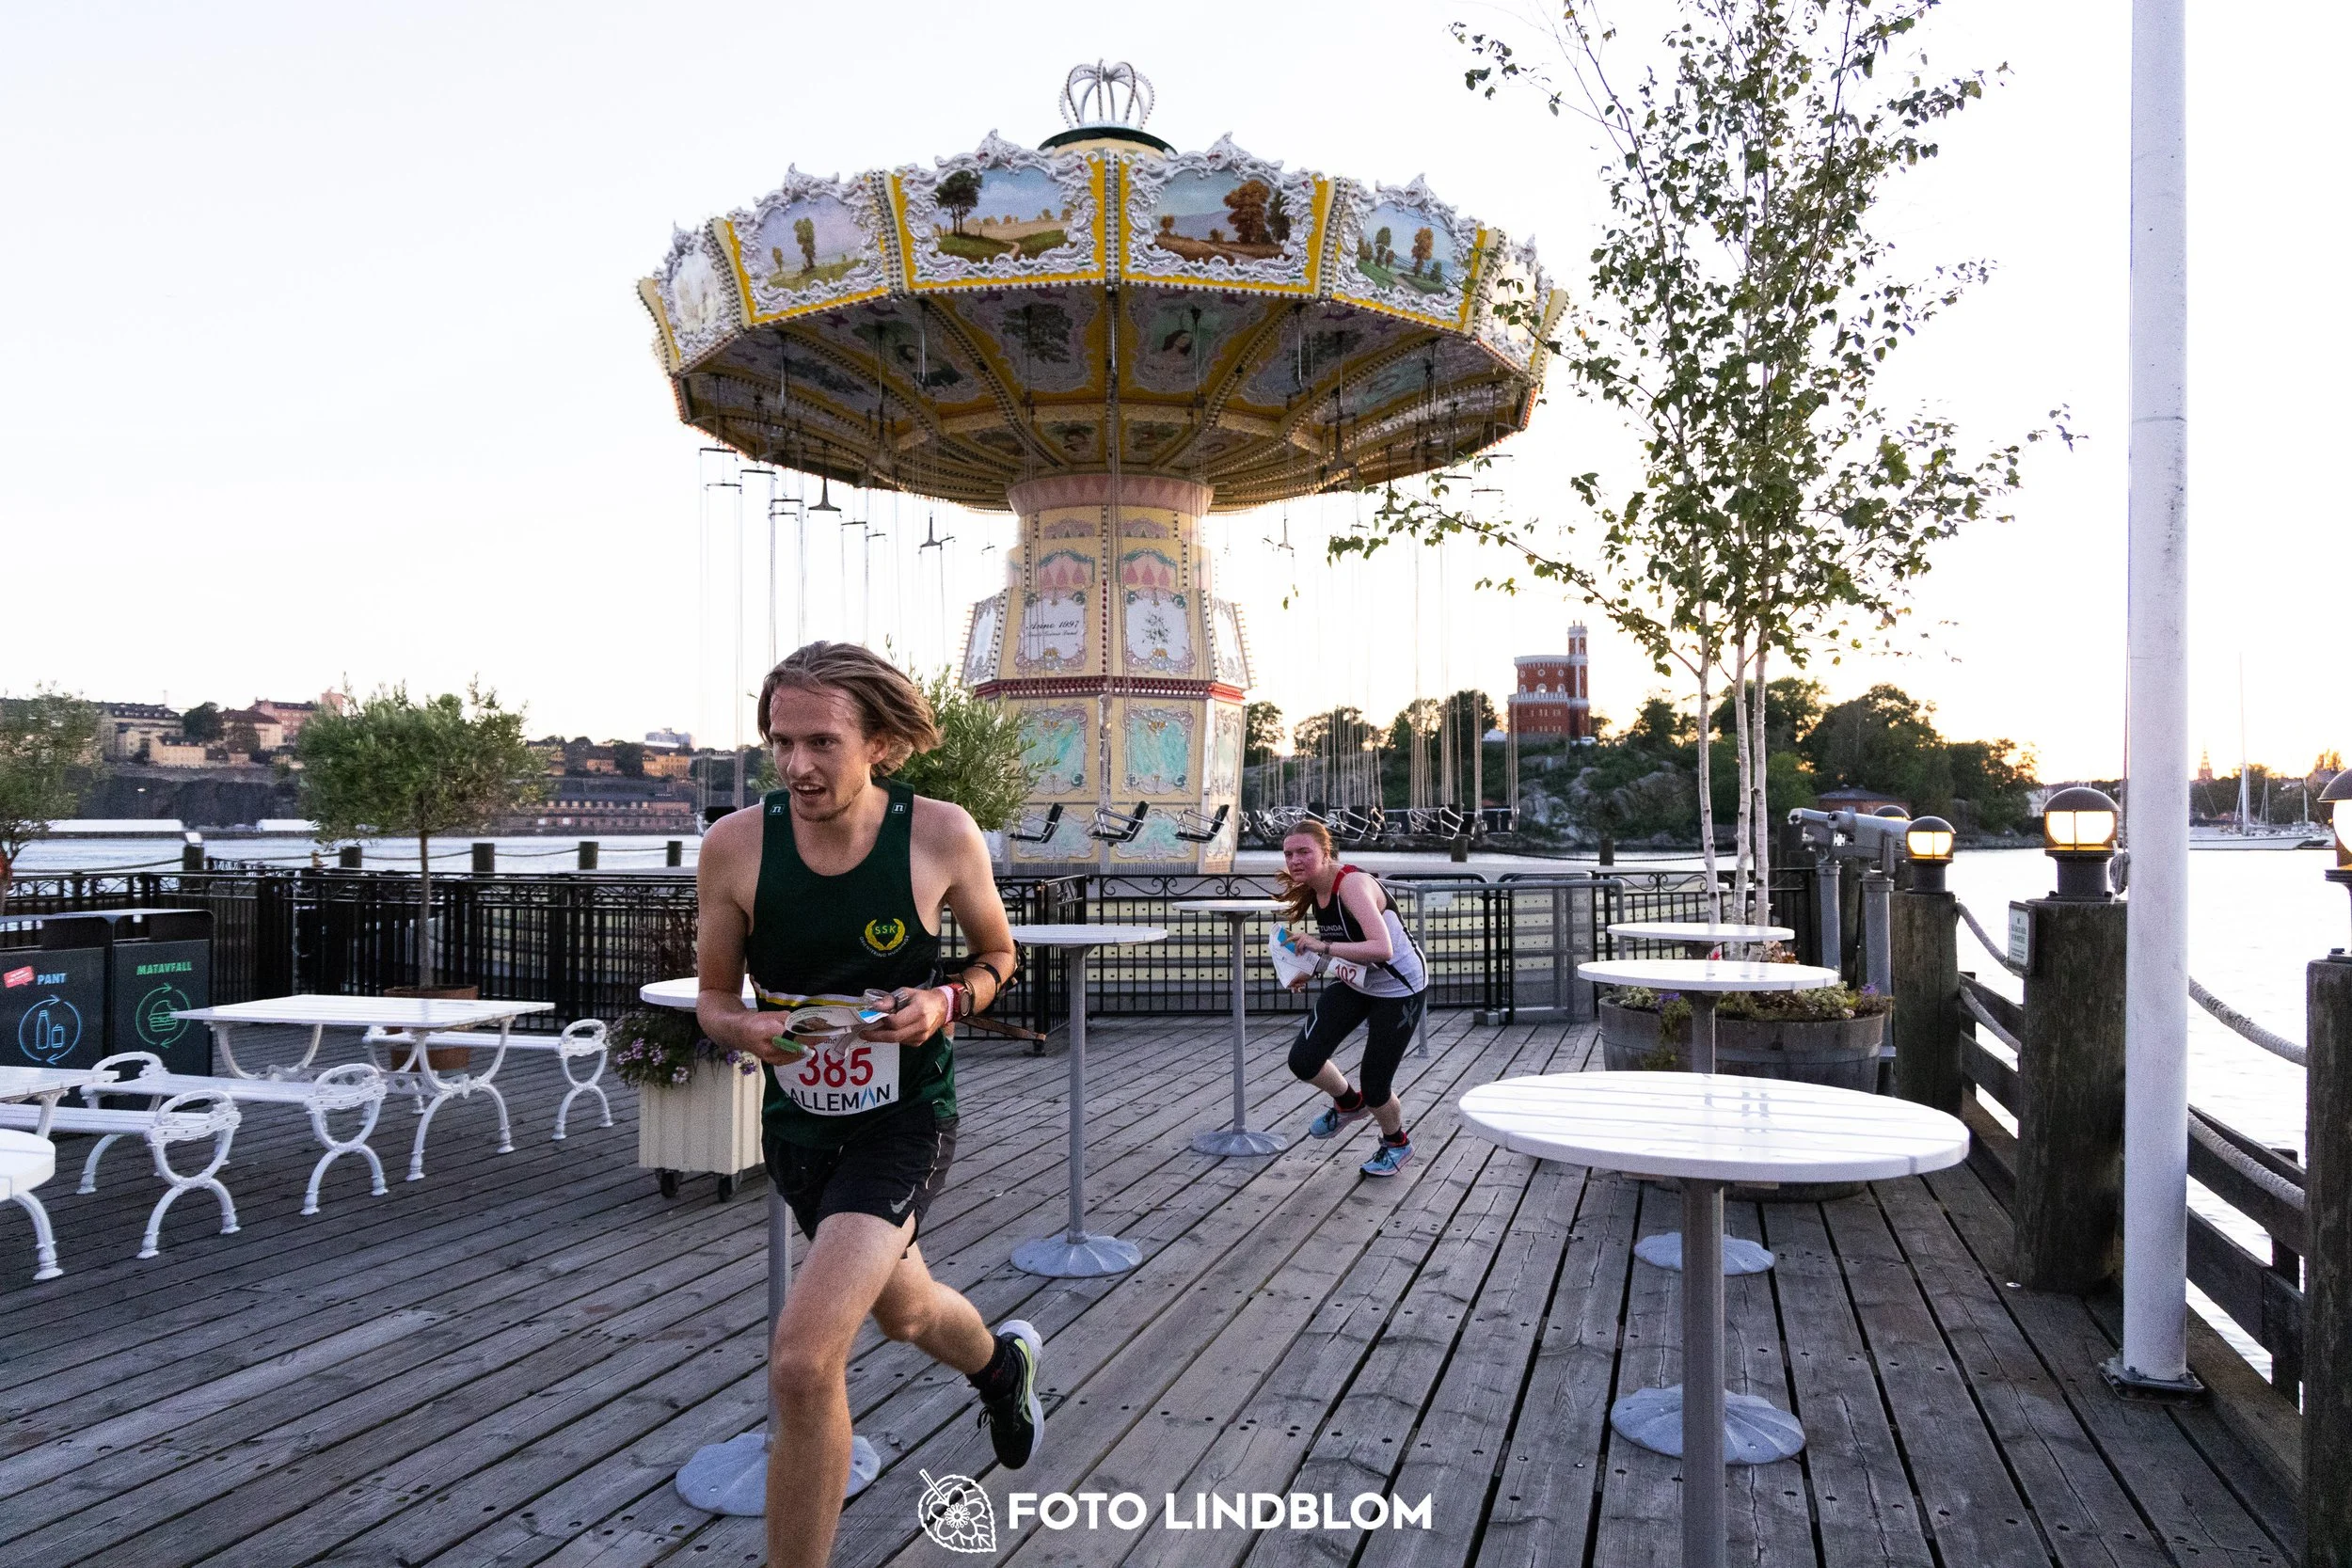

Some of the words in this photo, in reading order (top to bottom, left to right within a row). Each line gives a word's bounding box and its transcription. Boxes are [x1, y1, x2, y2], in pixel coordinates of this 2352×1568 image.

[875, 926, 897, 934] SSK
[136, 961, 192, 975] MATAVFALL
[1335, 964, 1357, 984] 102
[37, 973, 66, 985] PANT
[799, 1046, 873, 1087] 385
